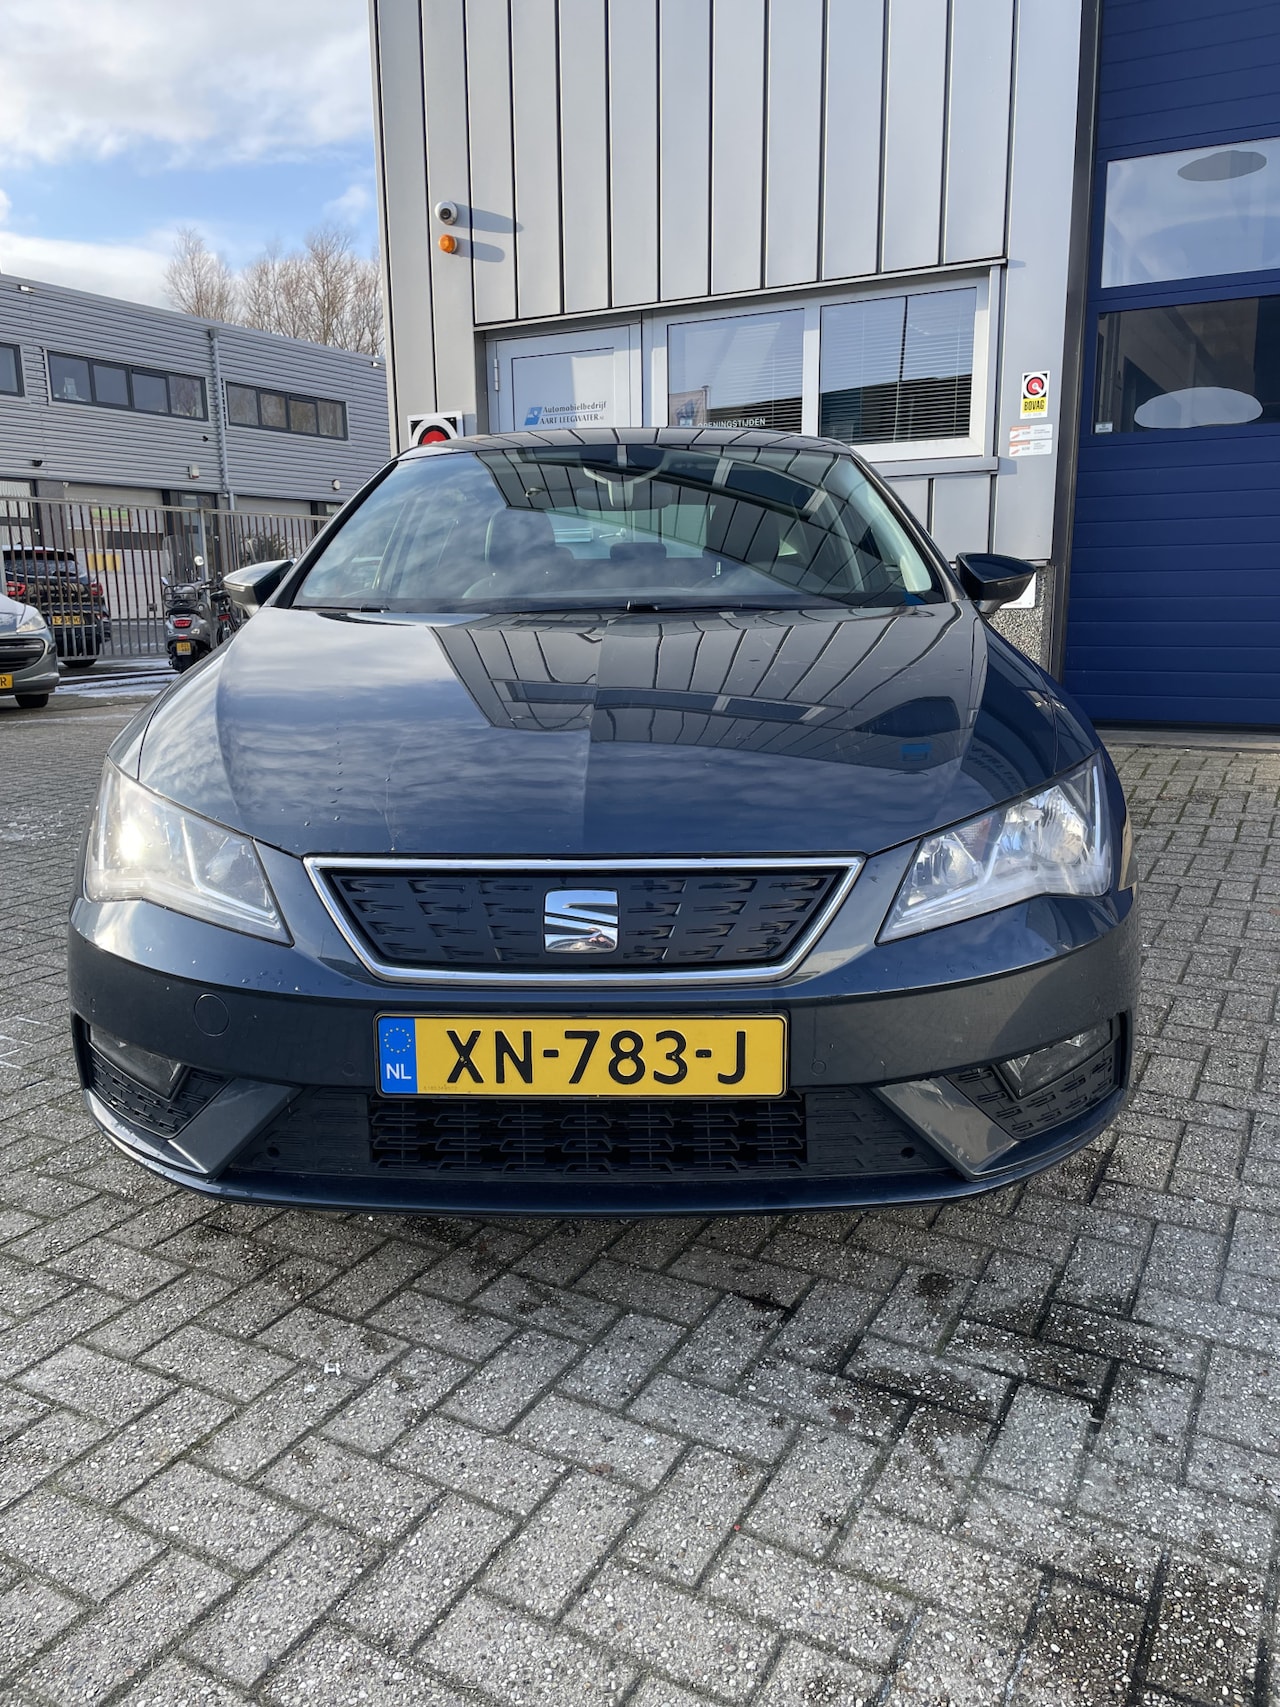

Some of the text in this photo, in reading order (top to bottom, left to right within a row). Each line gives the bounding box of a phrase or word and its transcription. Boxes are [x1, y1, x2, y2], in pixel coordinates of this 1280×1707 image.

[542, 401, 607, 413] Automobielbedrijf
[1024, 399, 1045, 411] BOVAG
[540, 416, 557, 425] AART
[559, 413, 599, 423] LEEGWATER
[446, 1030, 746, 1085] XN-783-J
[386, 1063, 412, 1080] NL
